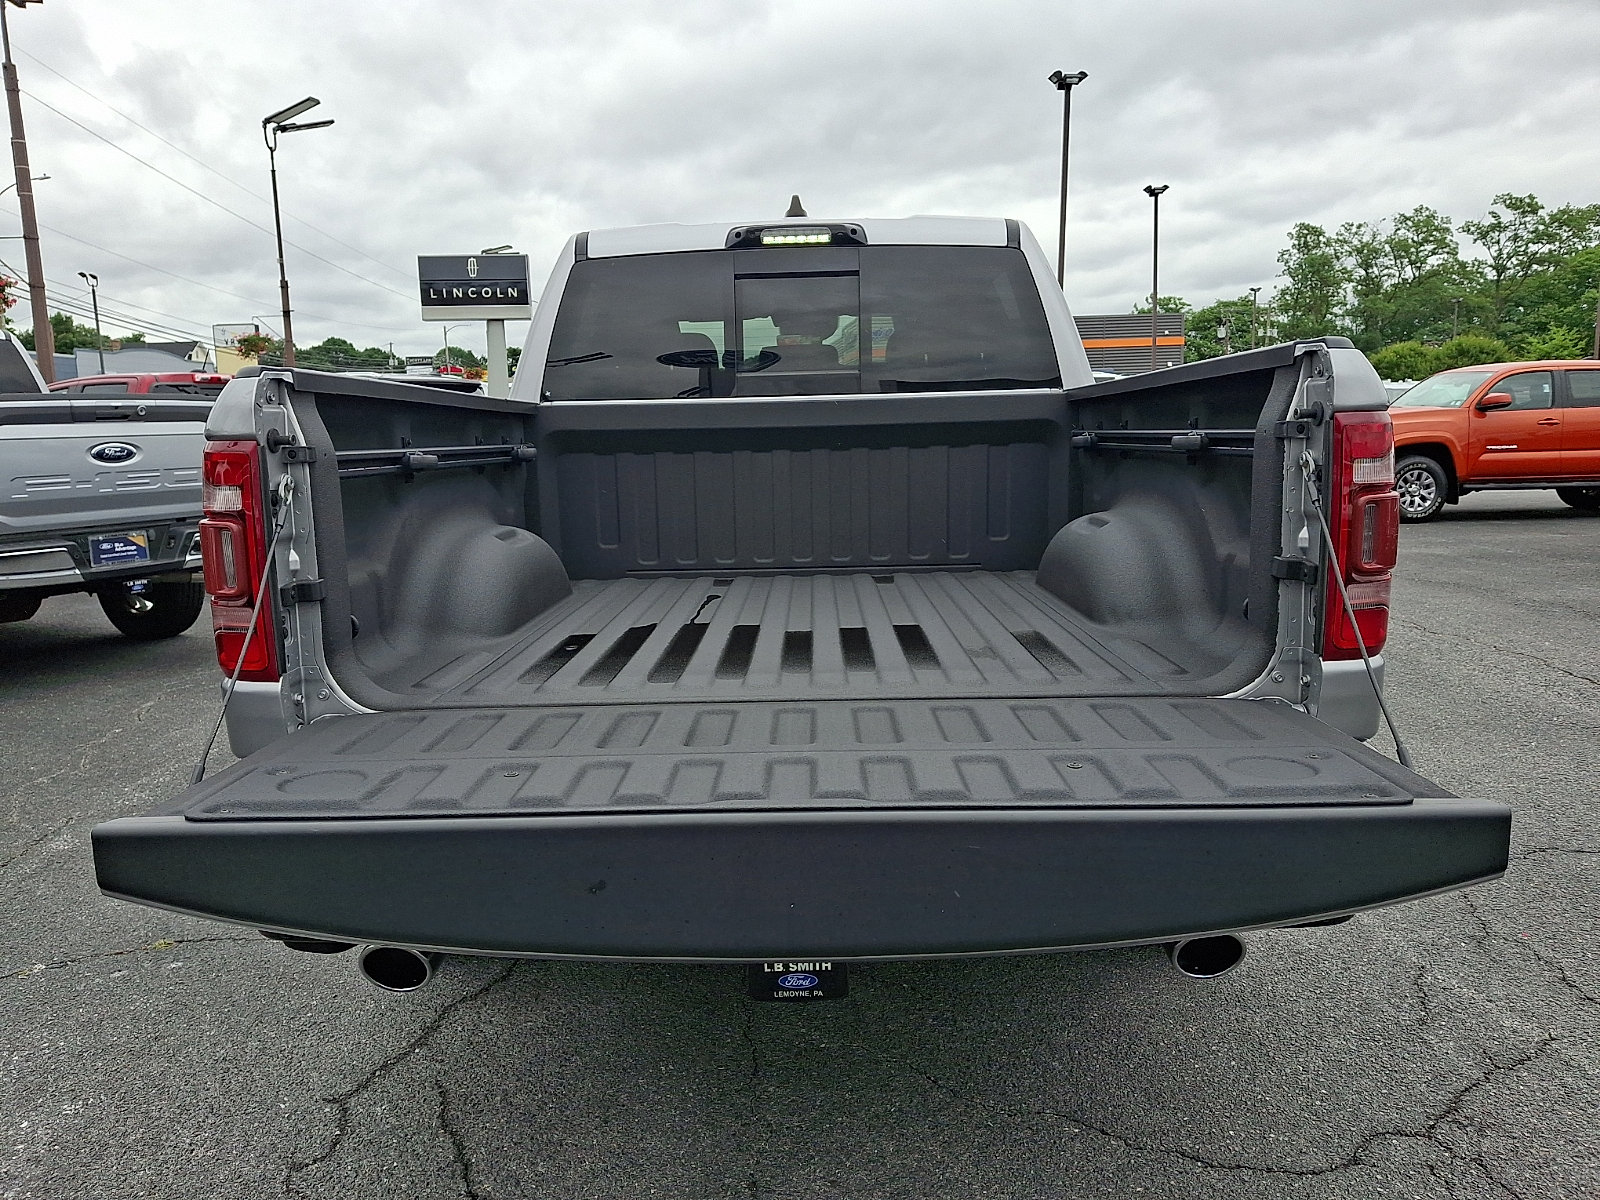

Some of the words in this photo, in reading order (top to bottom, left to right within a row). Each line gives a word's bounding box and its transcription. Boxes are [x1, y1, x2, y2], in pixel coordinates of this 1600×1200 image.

[430, 287, 518, 298] LINCOLN
[785, 976, 811, 986] Ford
[774, 990, 812, 998] LEMOYNE,
